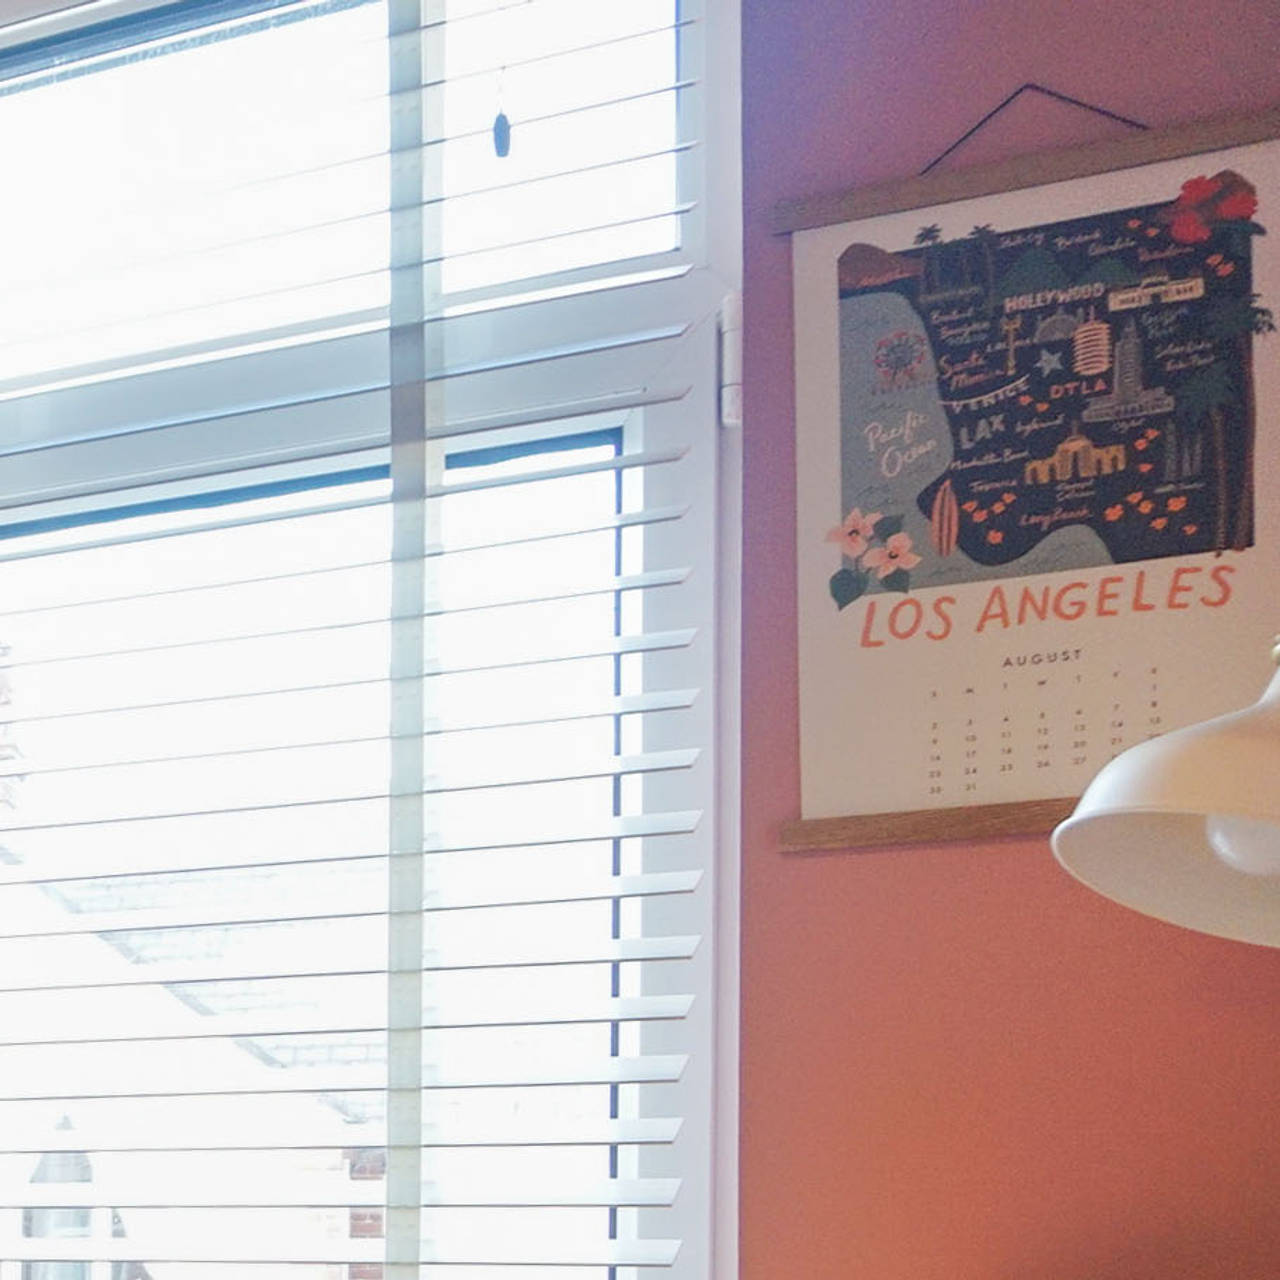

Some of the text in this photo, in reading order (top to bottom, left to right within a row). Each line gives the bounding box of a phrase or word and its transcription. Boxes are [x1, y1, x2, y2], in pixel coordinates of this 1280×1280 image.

[1005, 281, 1105, 313] HOLLYWOOD
[1049, 378, 1107, 399] DTLA
[864, 410, 929, 451] Pacific
[959, 414, 1006, 450] LAX
[881, 439, 937, 478] Ocean
[860, 564, 1238, 649] LOS ANGELES
[1002, 648, 1084, 668] AUGUST
